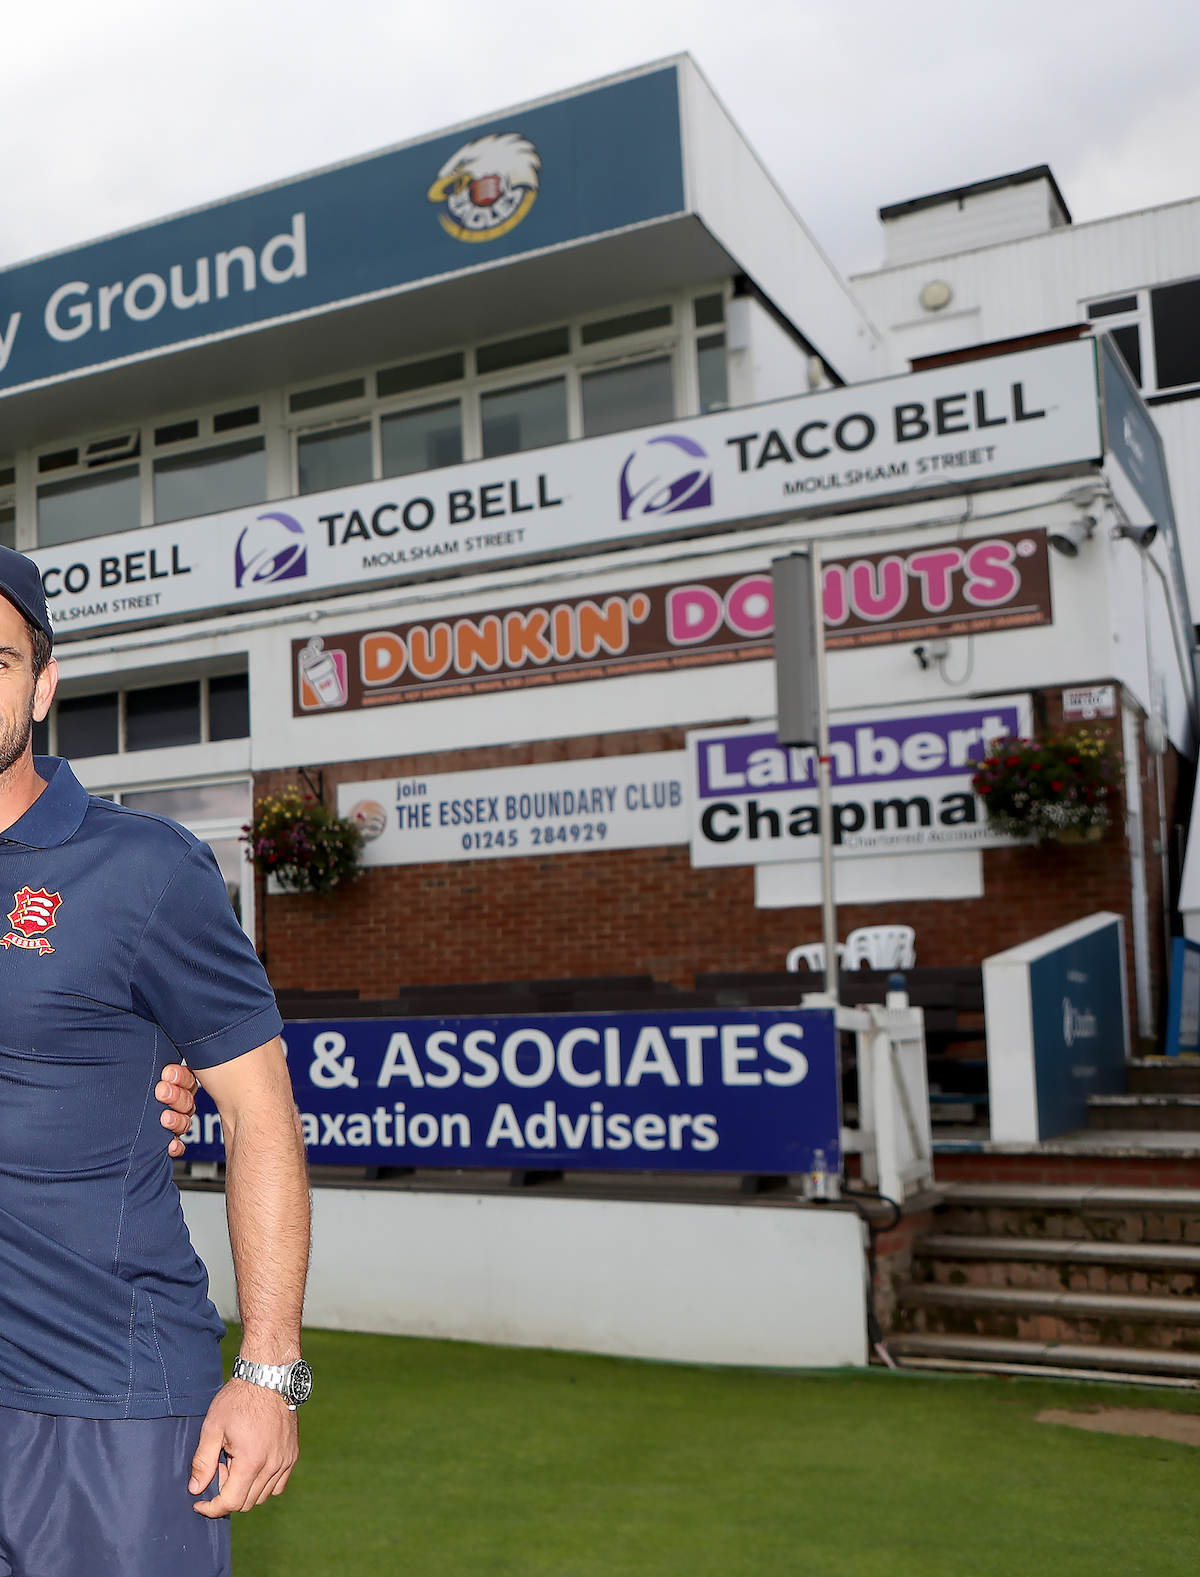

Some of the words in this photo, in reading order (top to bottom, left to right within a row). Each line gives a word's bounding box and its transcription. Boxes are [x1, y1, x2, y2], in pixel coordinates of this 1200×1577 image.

[43, 212, 309, 342] Ground
[726, 412, 876, 473] TACO
[893, 381, 1047, 443] BELL
[782, 460, 910, 498] MOULSHAM
[916, 444, 997, 474] STREET
[318, 497, 435, 547] TACO
[448, 474, 563, 524] BELL
[41, 562, 90, 599] CO
[100, 544, 192, 588] BELL
[362, 539, 460, 570] MOULSHAM
[465, 528, 526, 551] STREET
[52, 601, 108, 622] ULSHAM
[113, 593, 162, 613] STREET
[359, 592, 650, 687] DUNKIN'
[396, 781, 428, 801] join
[396, 803, 432, 829] THE
[439, 797, 499, 827] ESSEX
[505, 786, 618, 821] BOUNDARY
[625, 781, 682, 811] CLUB
[700, 789, 984, 844] Chapma
[462, 829, 519, 850] 01245
[531, 822, 608, 846] 284929
[308, 1031, 359, 1089] &
[376, 1022, 810, 1090] ASSOCIATES
[301, 1102, 472, 1148] axation
[485, 1100, 720, 1152] Advisers
